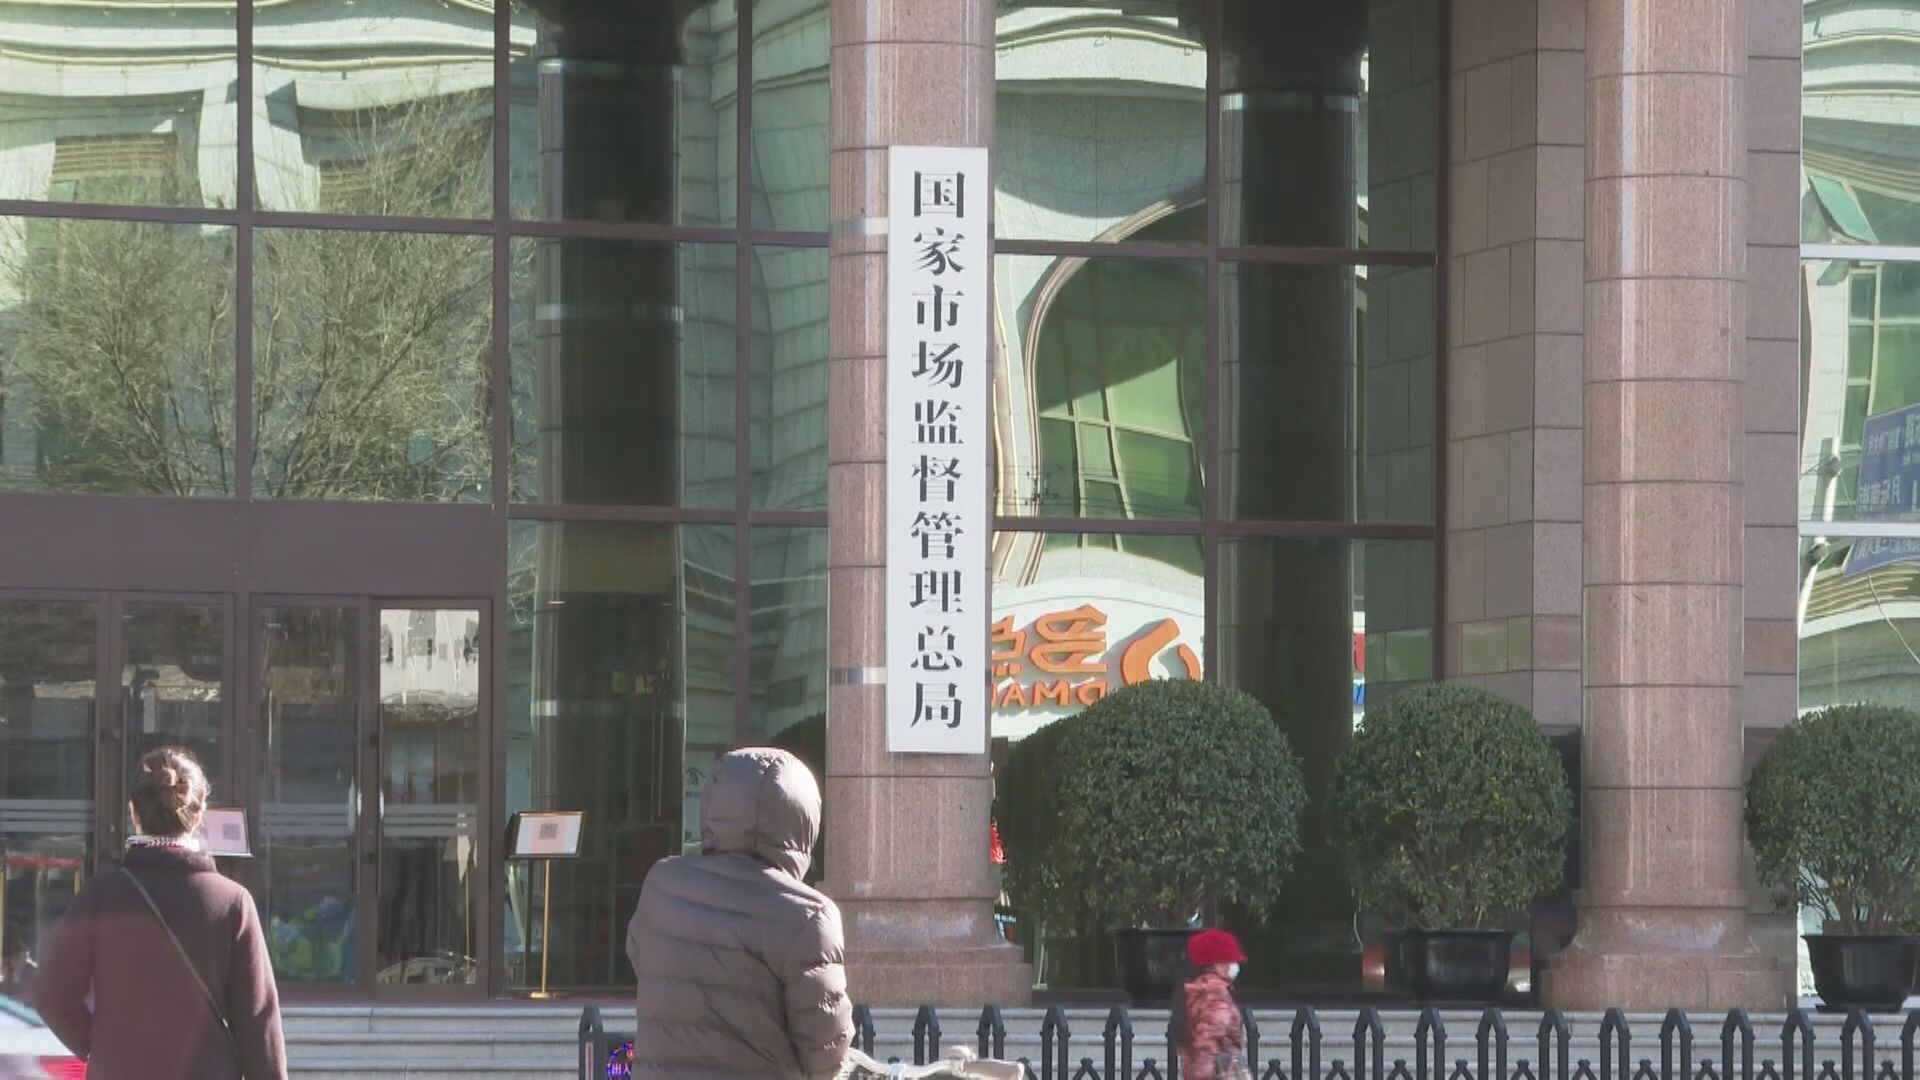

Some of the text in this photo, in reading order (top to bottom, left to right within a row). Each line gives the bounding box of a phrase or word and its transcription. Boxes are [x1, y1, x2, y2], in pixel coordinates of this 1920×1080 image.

[910, 170, 965, 728] 国家市场监督管理总局
